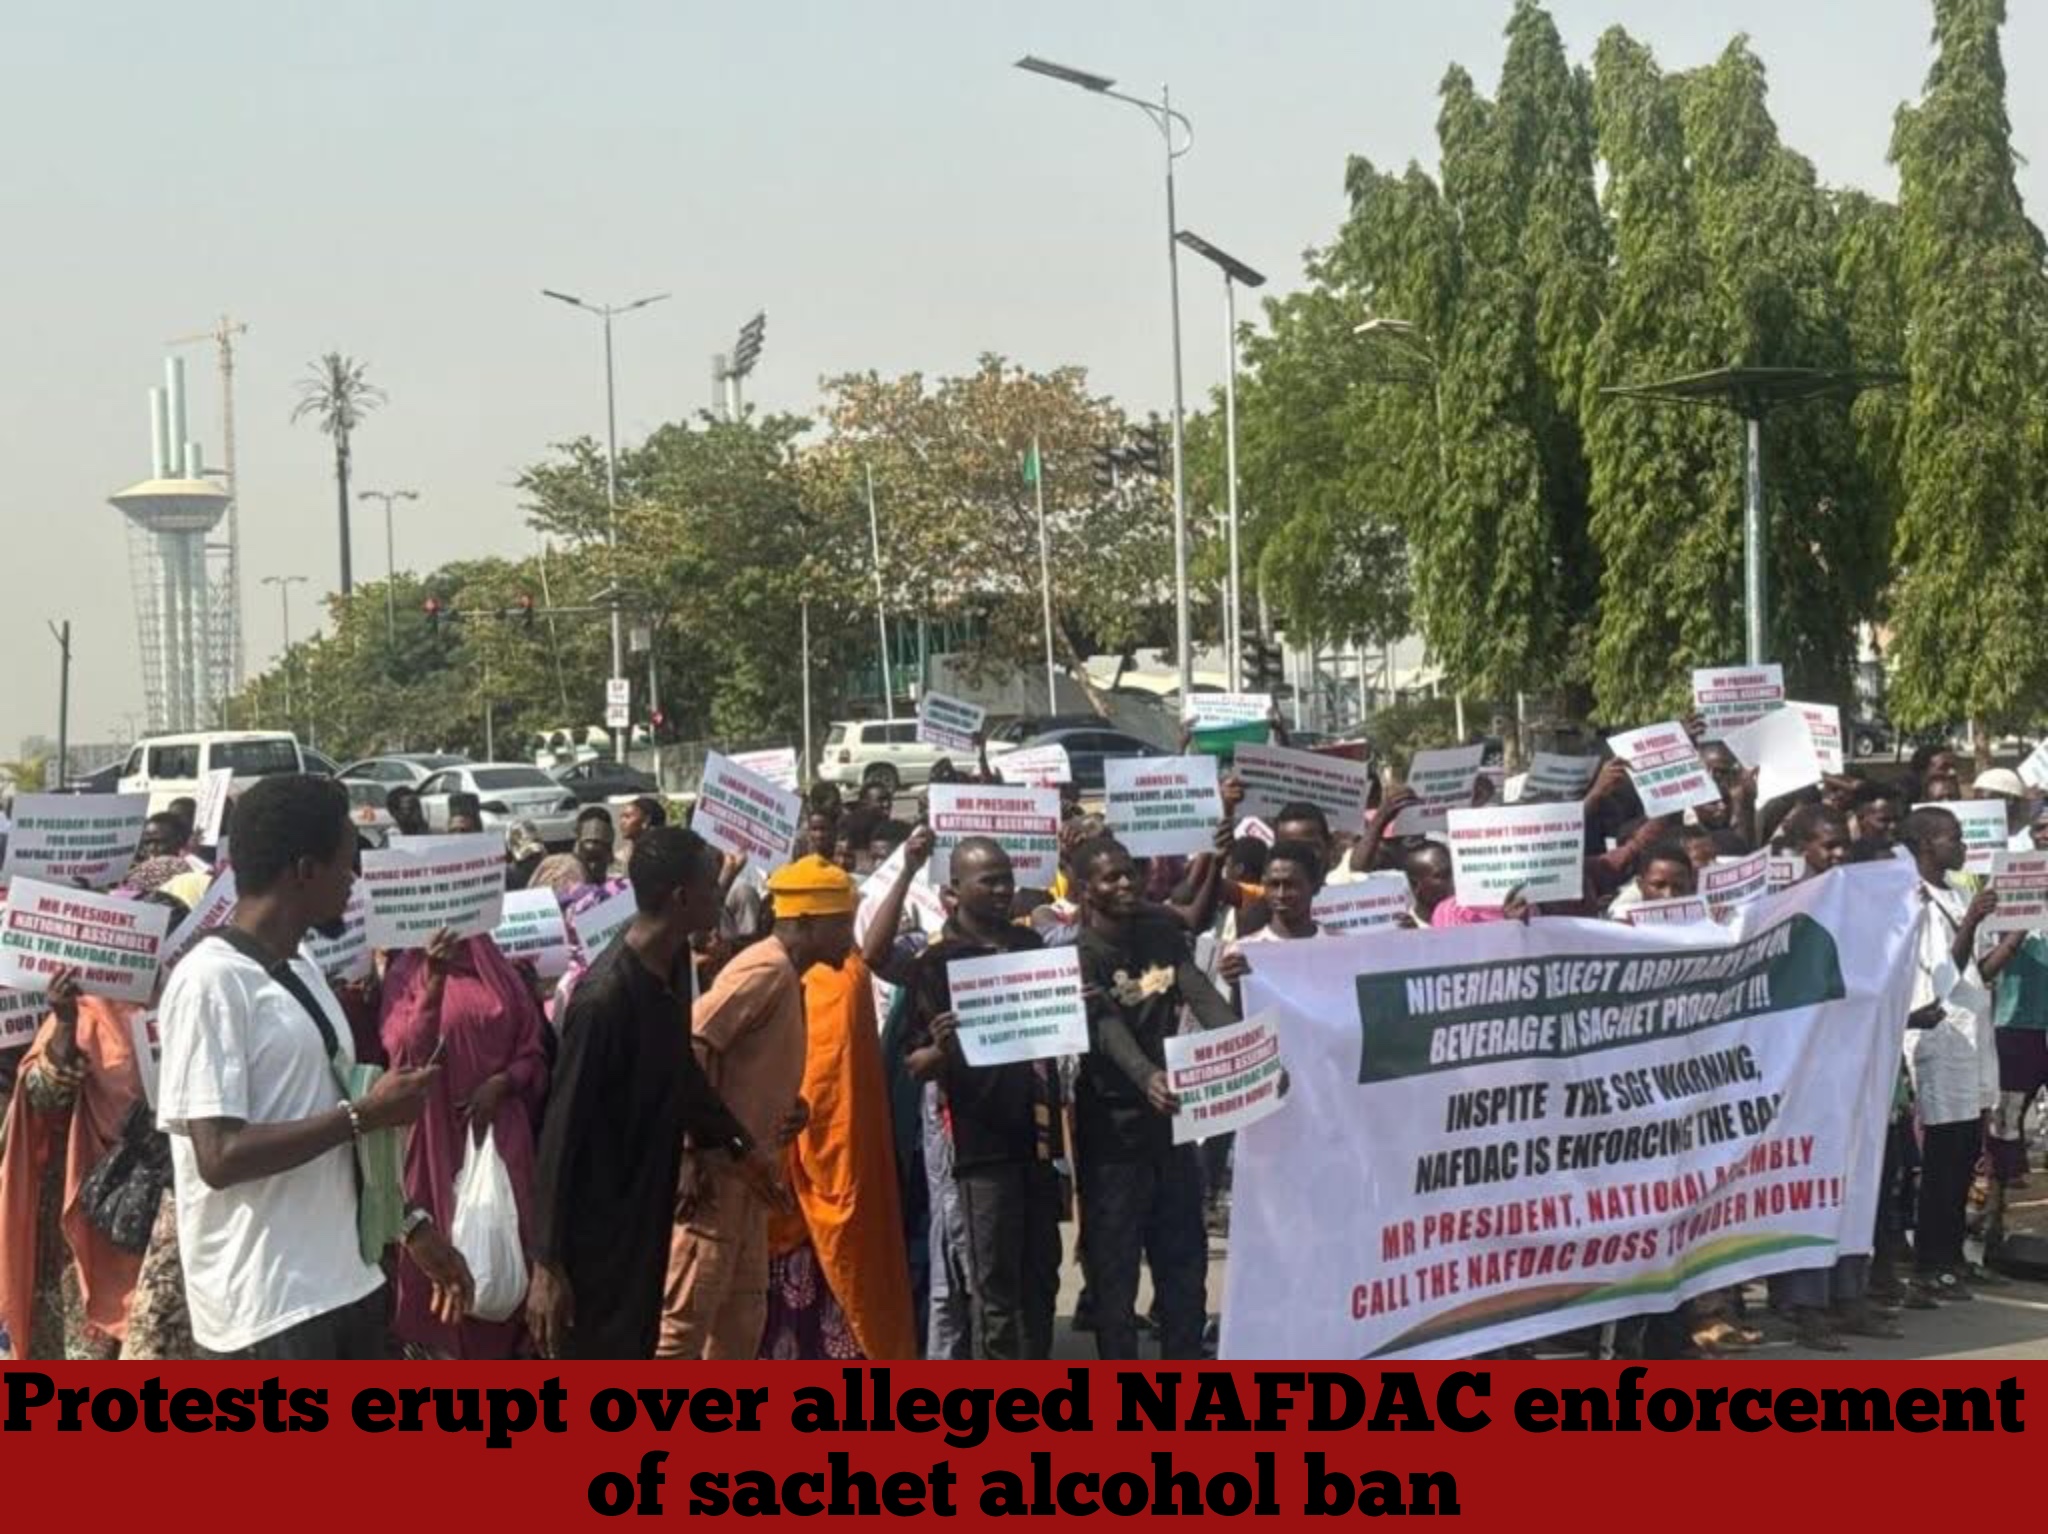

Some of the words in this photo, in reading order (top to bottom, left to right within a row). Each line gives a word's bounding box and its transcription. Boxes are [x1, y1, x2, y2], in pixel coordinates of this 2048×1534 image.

[14, 912, 78, 938] NATIONAL
[80, 924, 156, 952] ASSEMBLY
[38, 898, 61, 912] MR
[63, 902, 137, 927] PRESIDENT
[2, 932, 34, 949] CALL
[37, 938, 61, 953] THE
[64, 943, 117, 965] NAFDAC
[120, 953, 158, 970] BOSS
[18, 955, 36, 969] TO
[1406, 964, 1540, 1015] NIGERIANS
[1429, 1014, 1556, 1065] BEVERAGE
[1578, 1000, 1657, 1047] SACHET
[1445, 1082, 1548, 1133] INSPITE
[1564, 1076, 1612, 1118] THE
[1610, 1068, 1655, 1111] SGF
[1415, 1140, 1519, 1194] NAFDAC
[1525, 1136, 1551, 1176] IS
[1556, 1114, 1694, 1171] ENFORCING
[1695, 1103, 1737, 1146] THE
[1382, 1220, 1416, 1262] MR
[1422, 1194, 1582, 1249] PRESIDENT,
[1587, 1171, 1708, 1223] NATIONAL
[1351, 1273, 1410, 1321] CALL
[1415, 1259, 1460, 1302] THE
[1467, 1241, 1576, 1290] NAFDAC
[1581, 1228, 1659, 1268] BOSS
